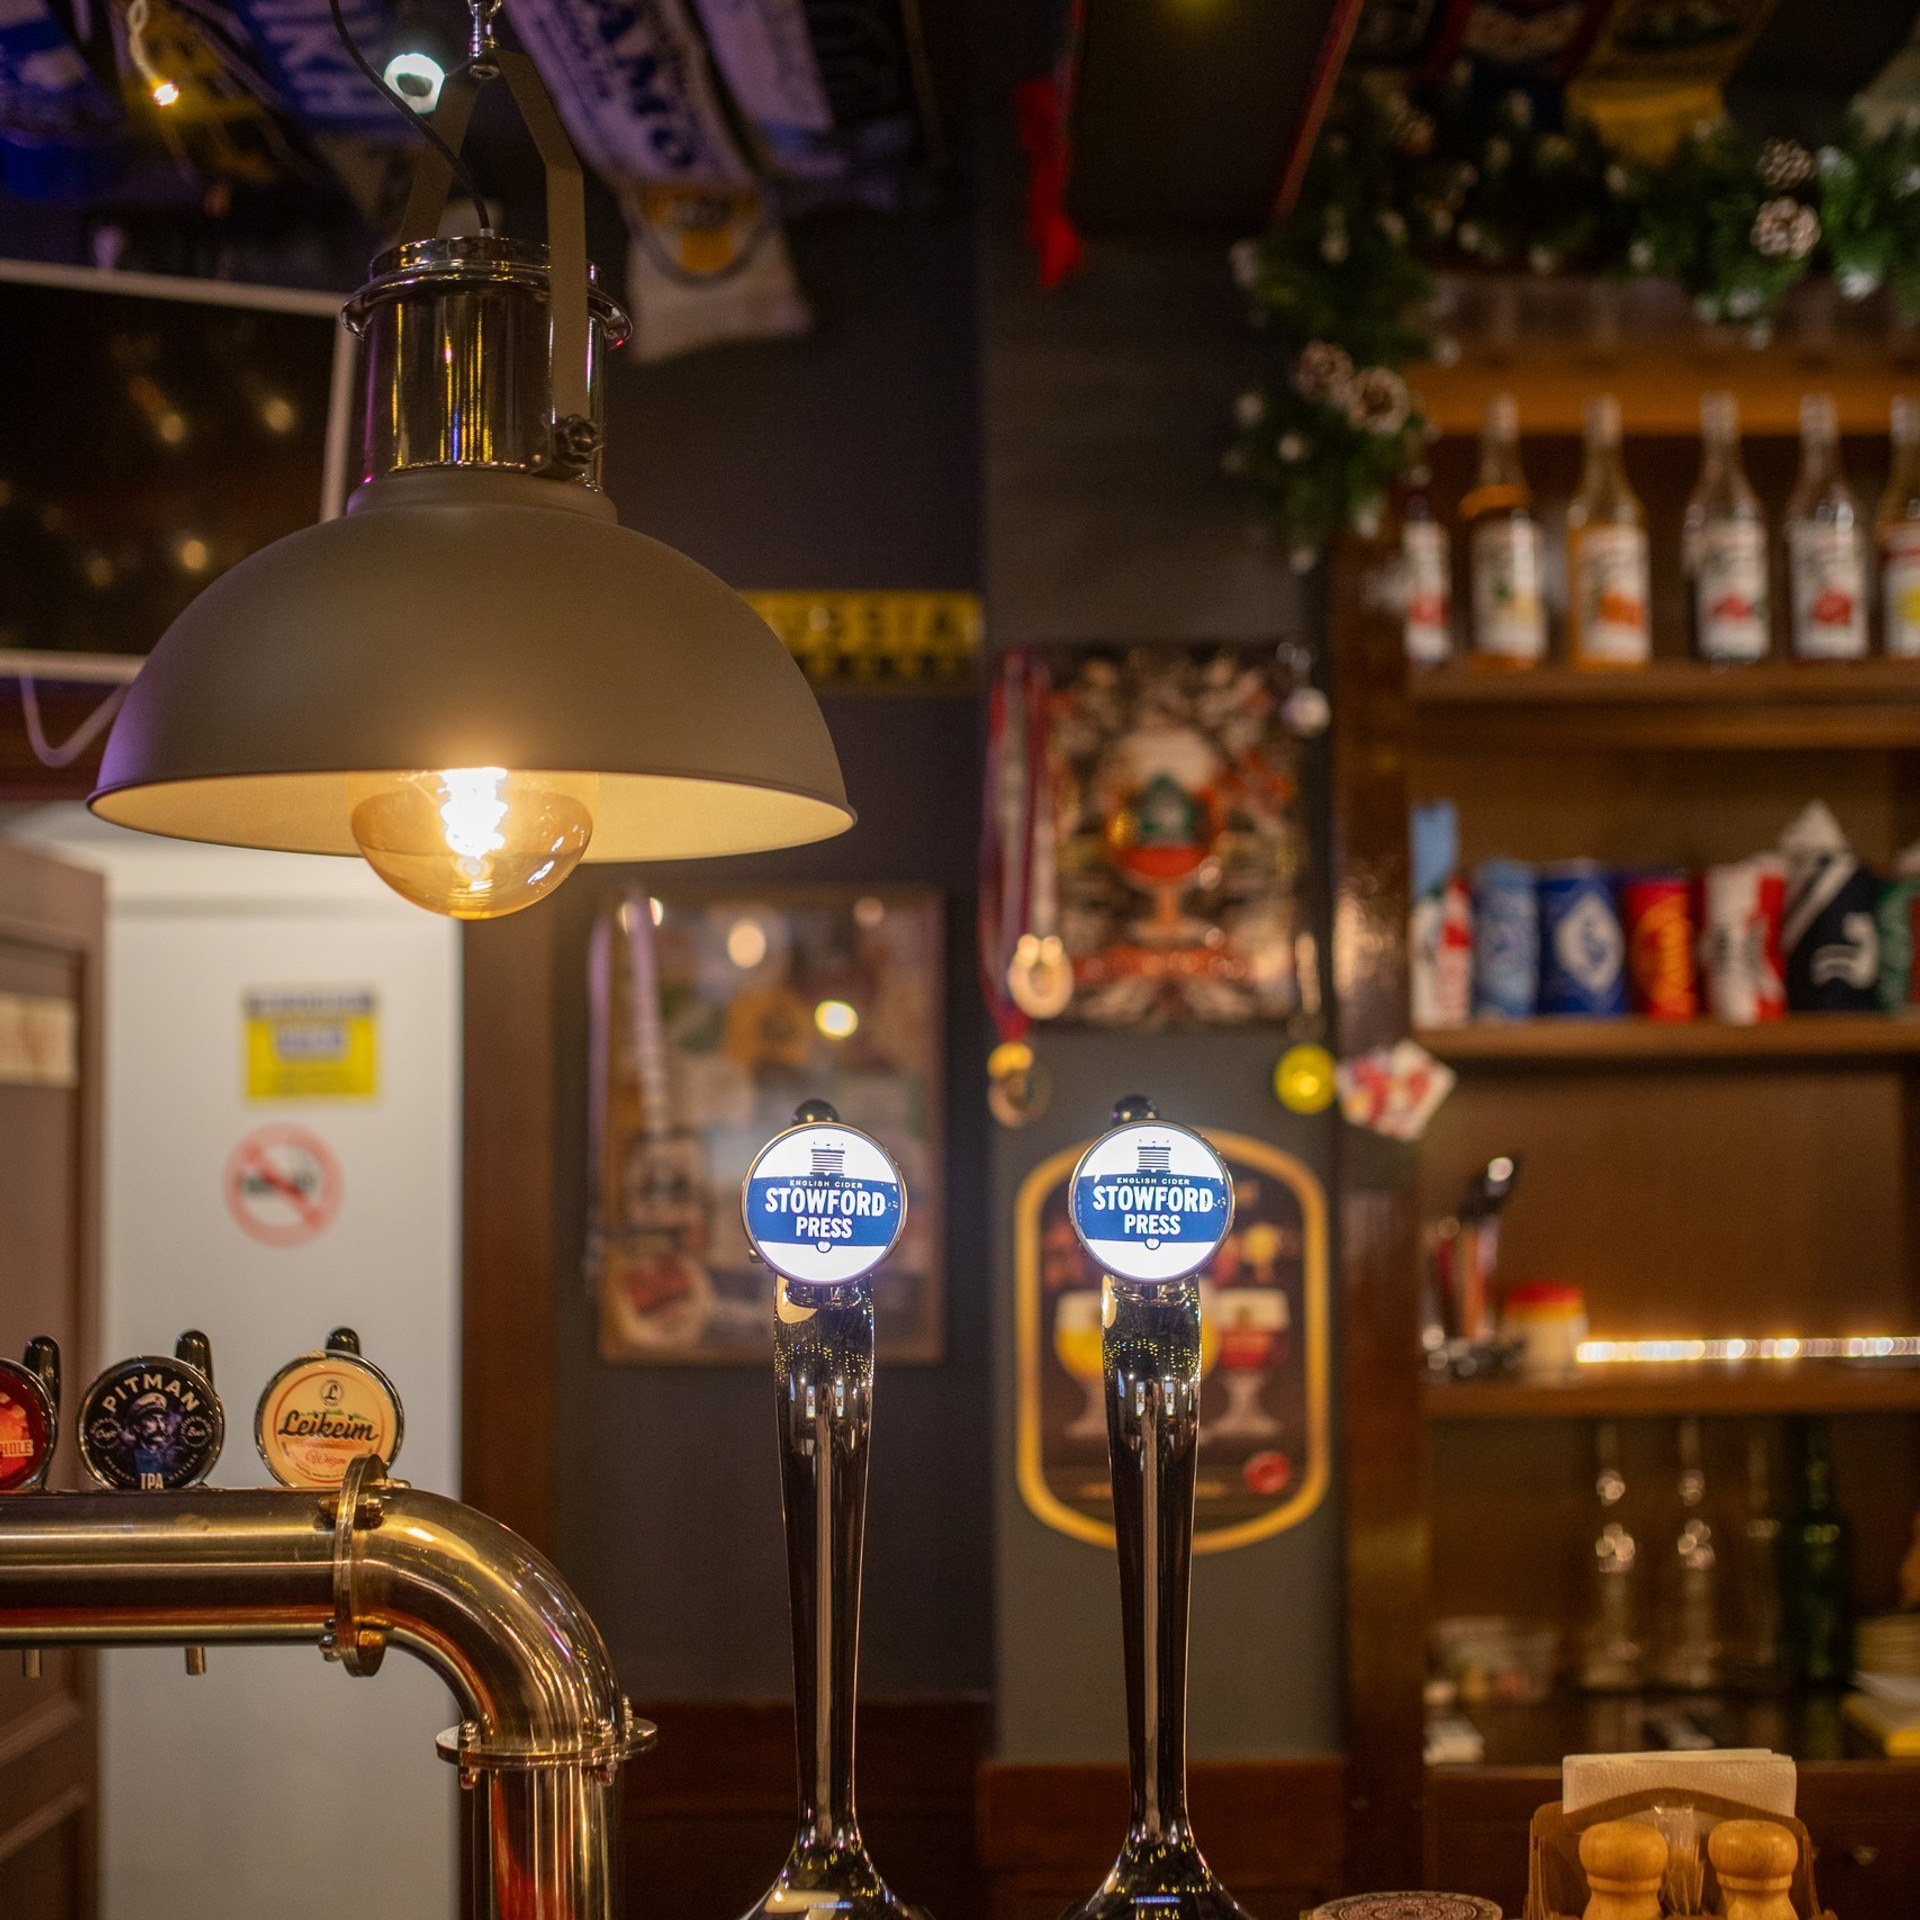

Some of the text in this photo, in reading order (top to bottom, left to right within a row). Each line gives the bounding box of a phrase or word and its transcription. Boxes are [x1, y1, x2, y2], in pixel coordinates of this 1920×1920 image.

[789, 1179, 863, 1189] ENGLISH CIDER
[765, 1187, 887, 1217] STOWFORD
[1092, 1185, 1214, 1213] STOWFORD
[796, 1216, 853, 1239] PRESS
[1124, 1214, 1181, 1236] PRESS
[101, 1373, 200, 1413] PITMAN
[277, 1409, 379, 1441] Leikeim
[140, 1472, 164, 1490] IPA
